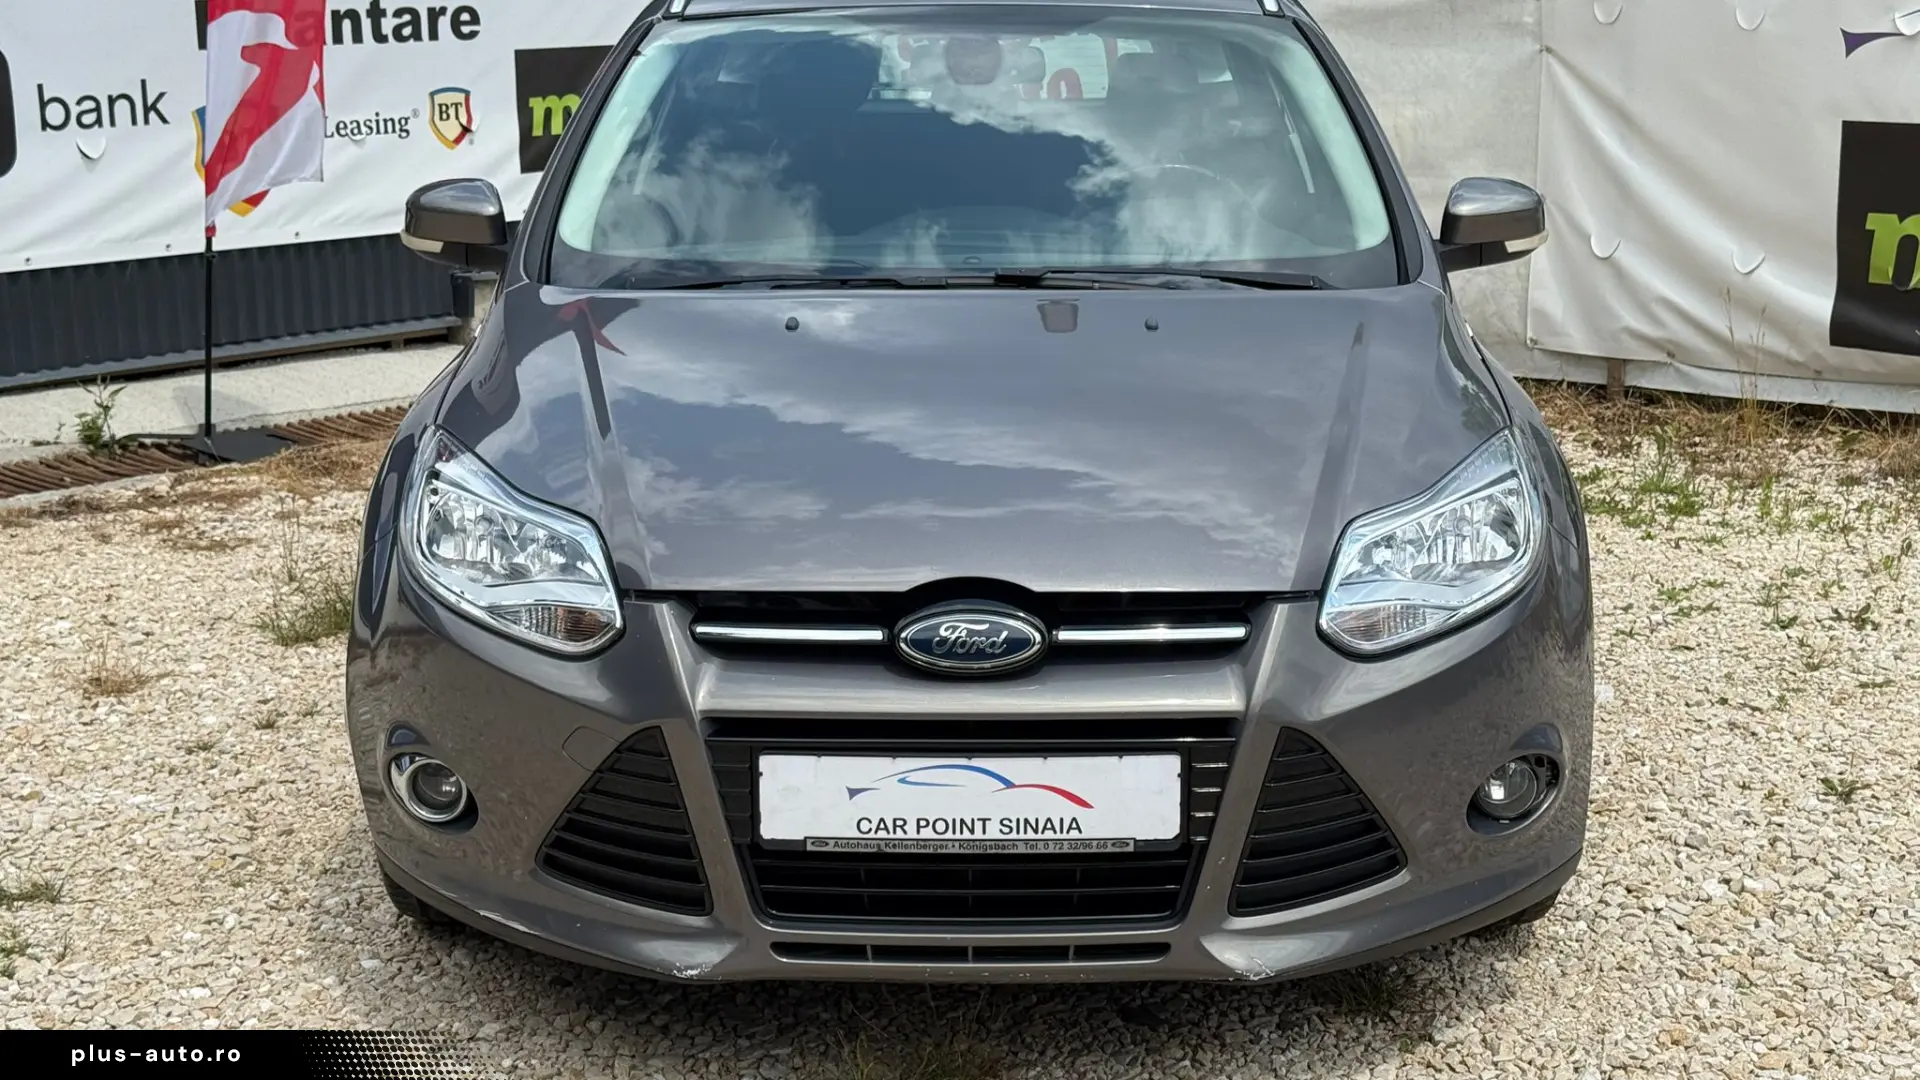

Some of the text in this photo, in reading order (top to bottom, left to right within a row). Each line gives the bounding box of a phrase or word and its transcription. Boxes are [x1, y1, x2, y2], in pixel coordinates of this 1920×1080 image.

[37, 78, 170, 132] bank
[437, 101, 463, 122] BT
[932, 622, 1009, 655] Ford
[856, 816, 1083, 836] CAR POINT SINAIA
[1023, 842, 1041, 851] Tel.
[1053, 842, 1065, 850] 72
